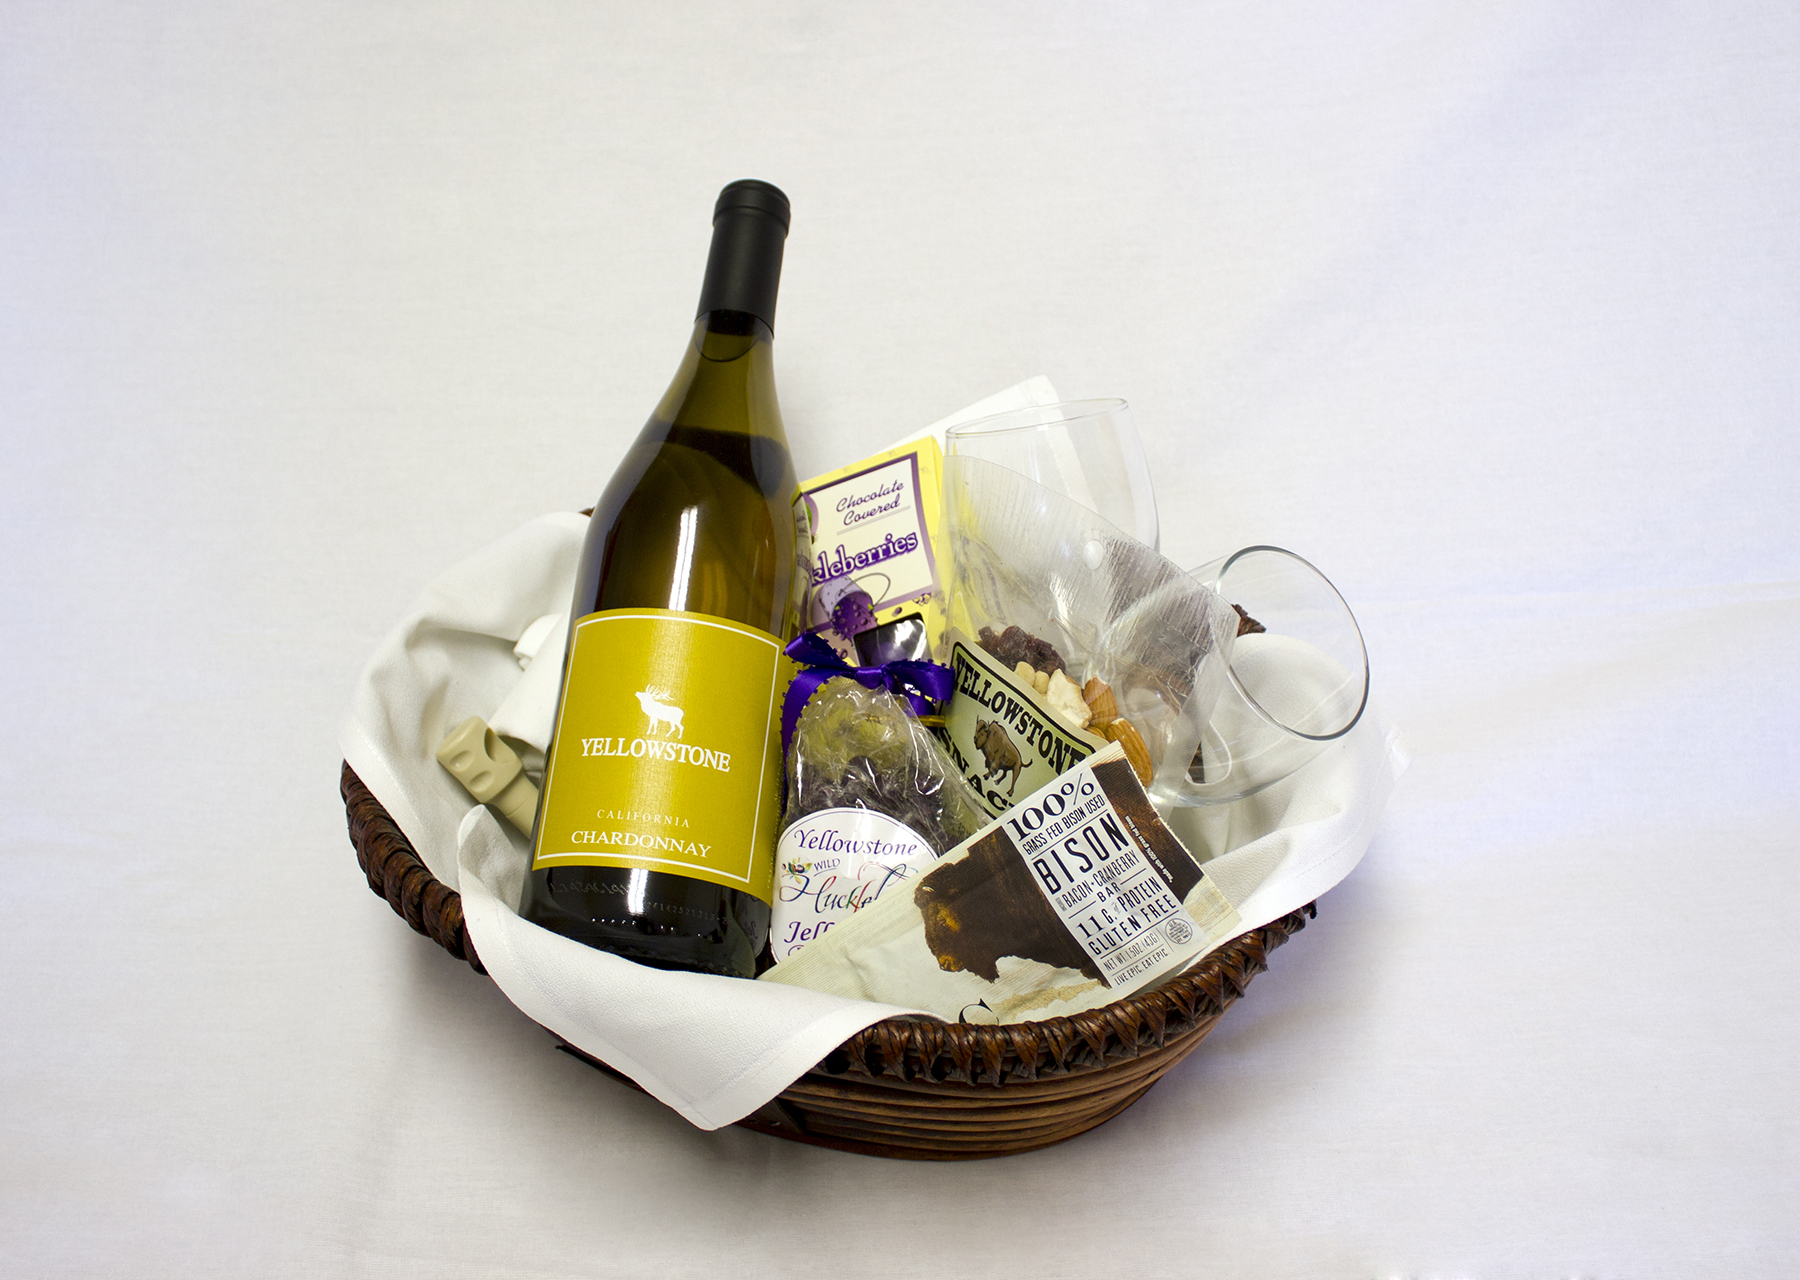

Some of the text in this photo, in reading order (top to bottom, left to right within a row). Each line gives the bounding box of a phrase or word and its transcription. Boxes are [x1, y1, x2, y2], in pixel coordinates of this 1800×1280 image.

[836, 479, 904, 512] Chocolate
[843, 493, 901, 525] Covered
[812, 532, 918, 587] kleberries
[581, 738, 731, 772] YELLOWSTONE
[597, 809, 690, 828] CALIFORNIA
[1007, 773, 1095, 842] 100%
[1022, 794, 1106, 855] GRASS FED BISON USED
[571, 831, 711, 858] CHARDONNAY
[794, 829, 917, 856] Yellowstone
[1033, 813, 1130, 895] BISON
[814, 858, 841, 872] WILD
[1076, 916, 1106, 939] 11
[1117, 876, 1163, 912] PROTEIN
[1097, 882, 1121, 902] BAR
[1088, 914, 1142, 955] GLUTEN
[1141, 894, 1176, 923] FREE
[1103, 958, 1118, 971] NET
[1114, 948, 1170, 985] LIVE EPIC. EAT EPIC.
